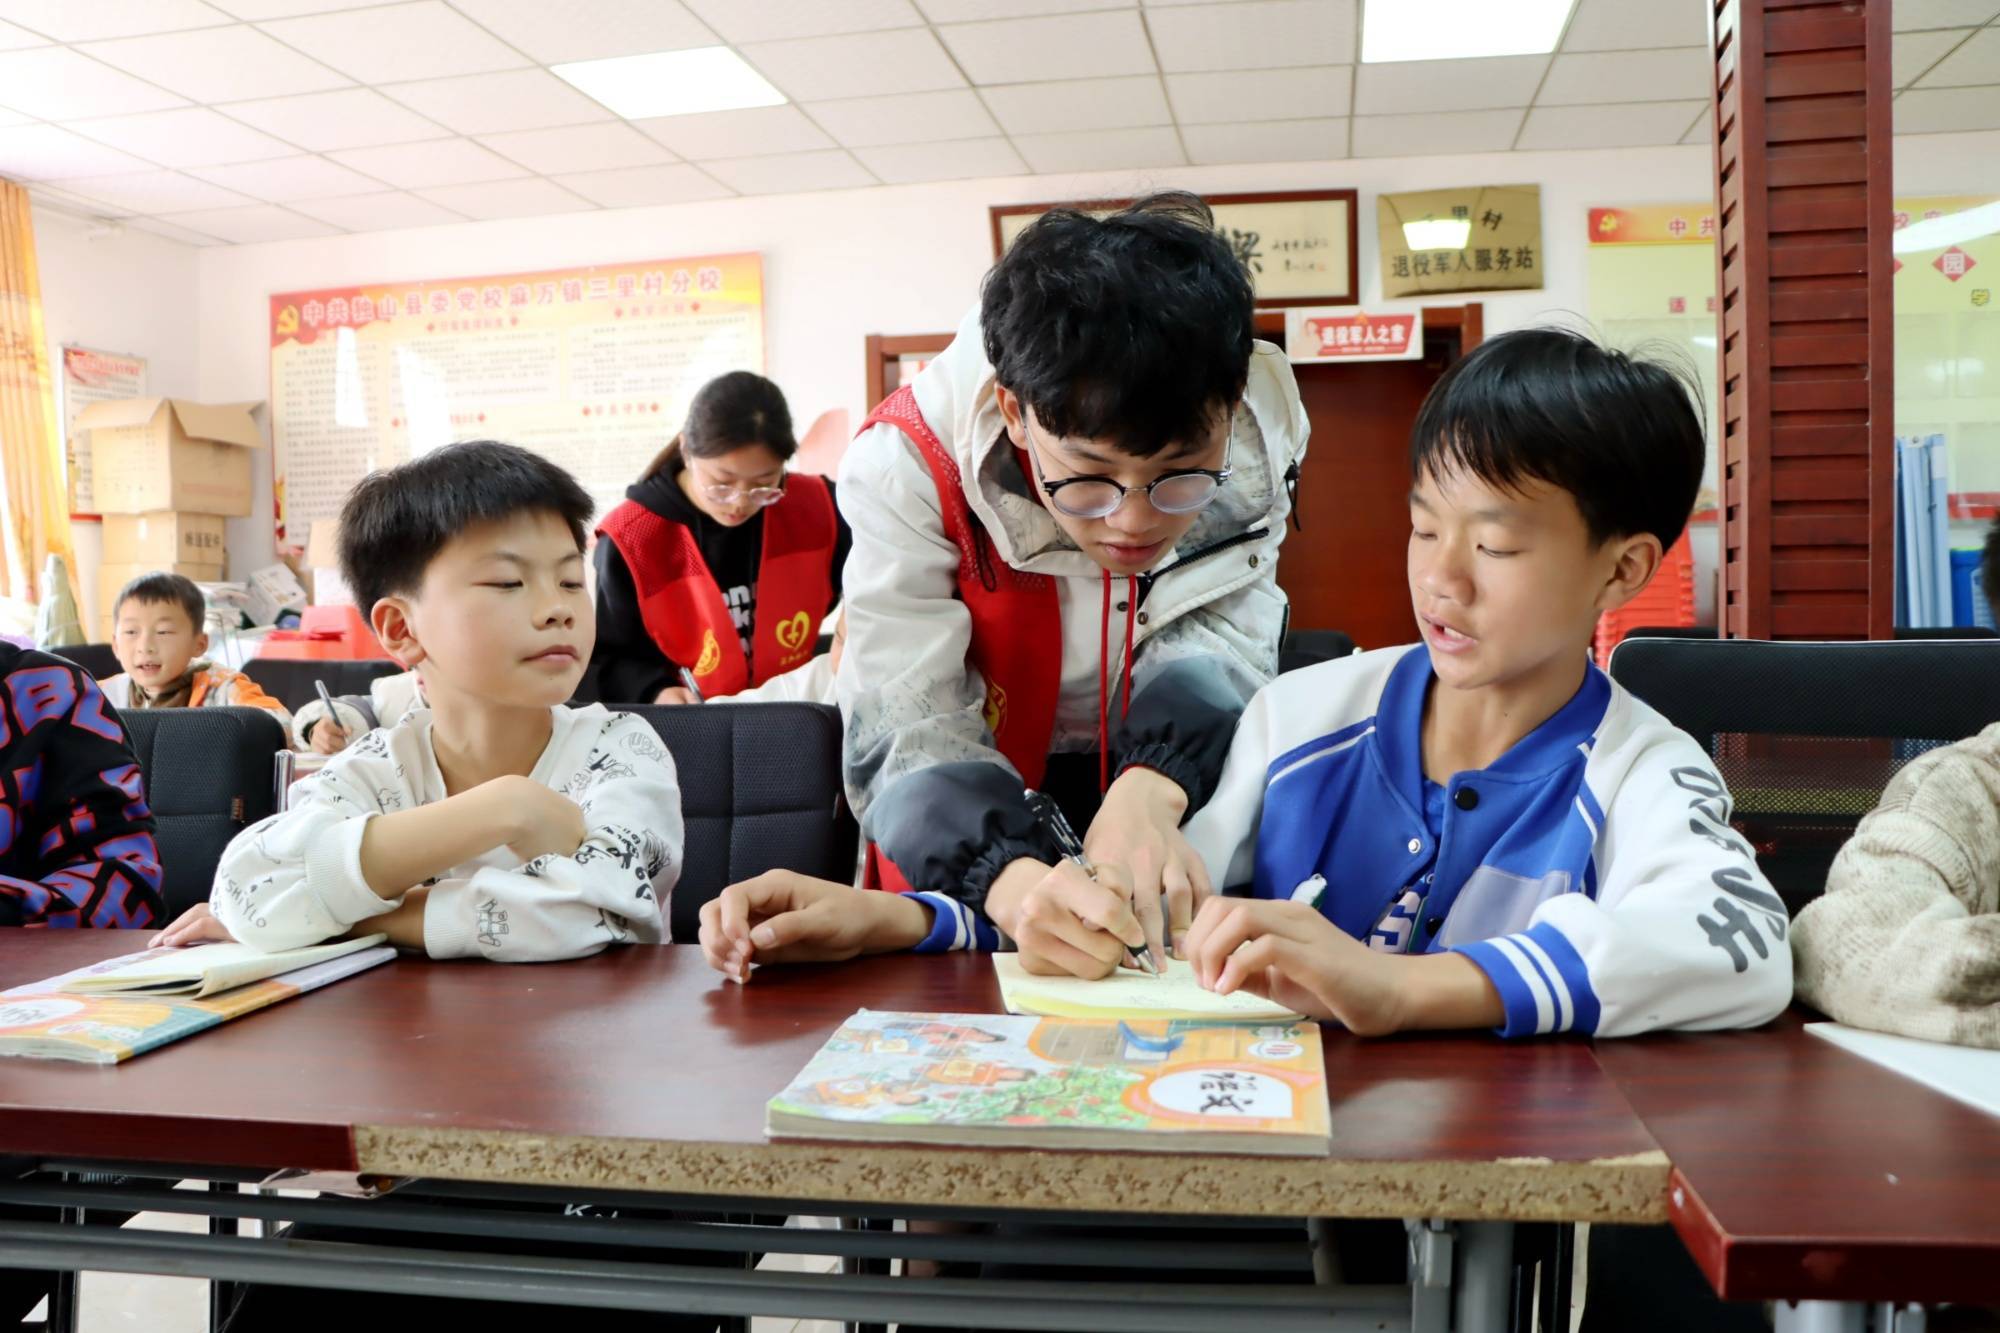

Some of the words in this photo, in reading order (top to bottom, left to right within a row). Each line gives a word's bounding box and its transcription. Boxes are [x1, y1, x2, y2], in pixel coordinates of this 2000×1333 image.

[1393, 245, 1534, 278] 退役军人服务站
[1322, 324, 1404, 346] 退役军人之家
